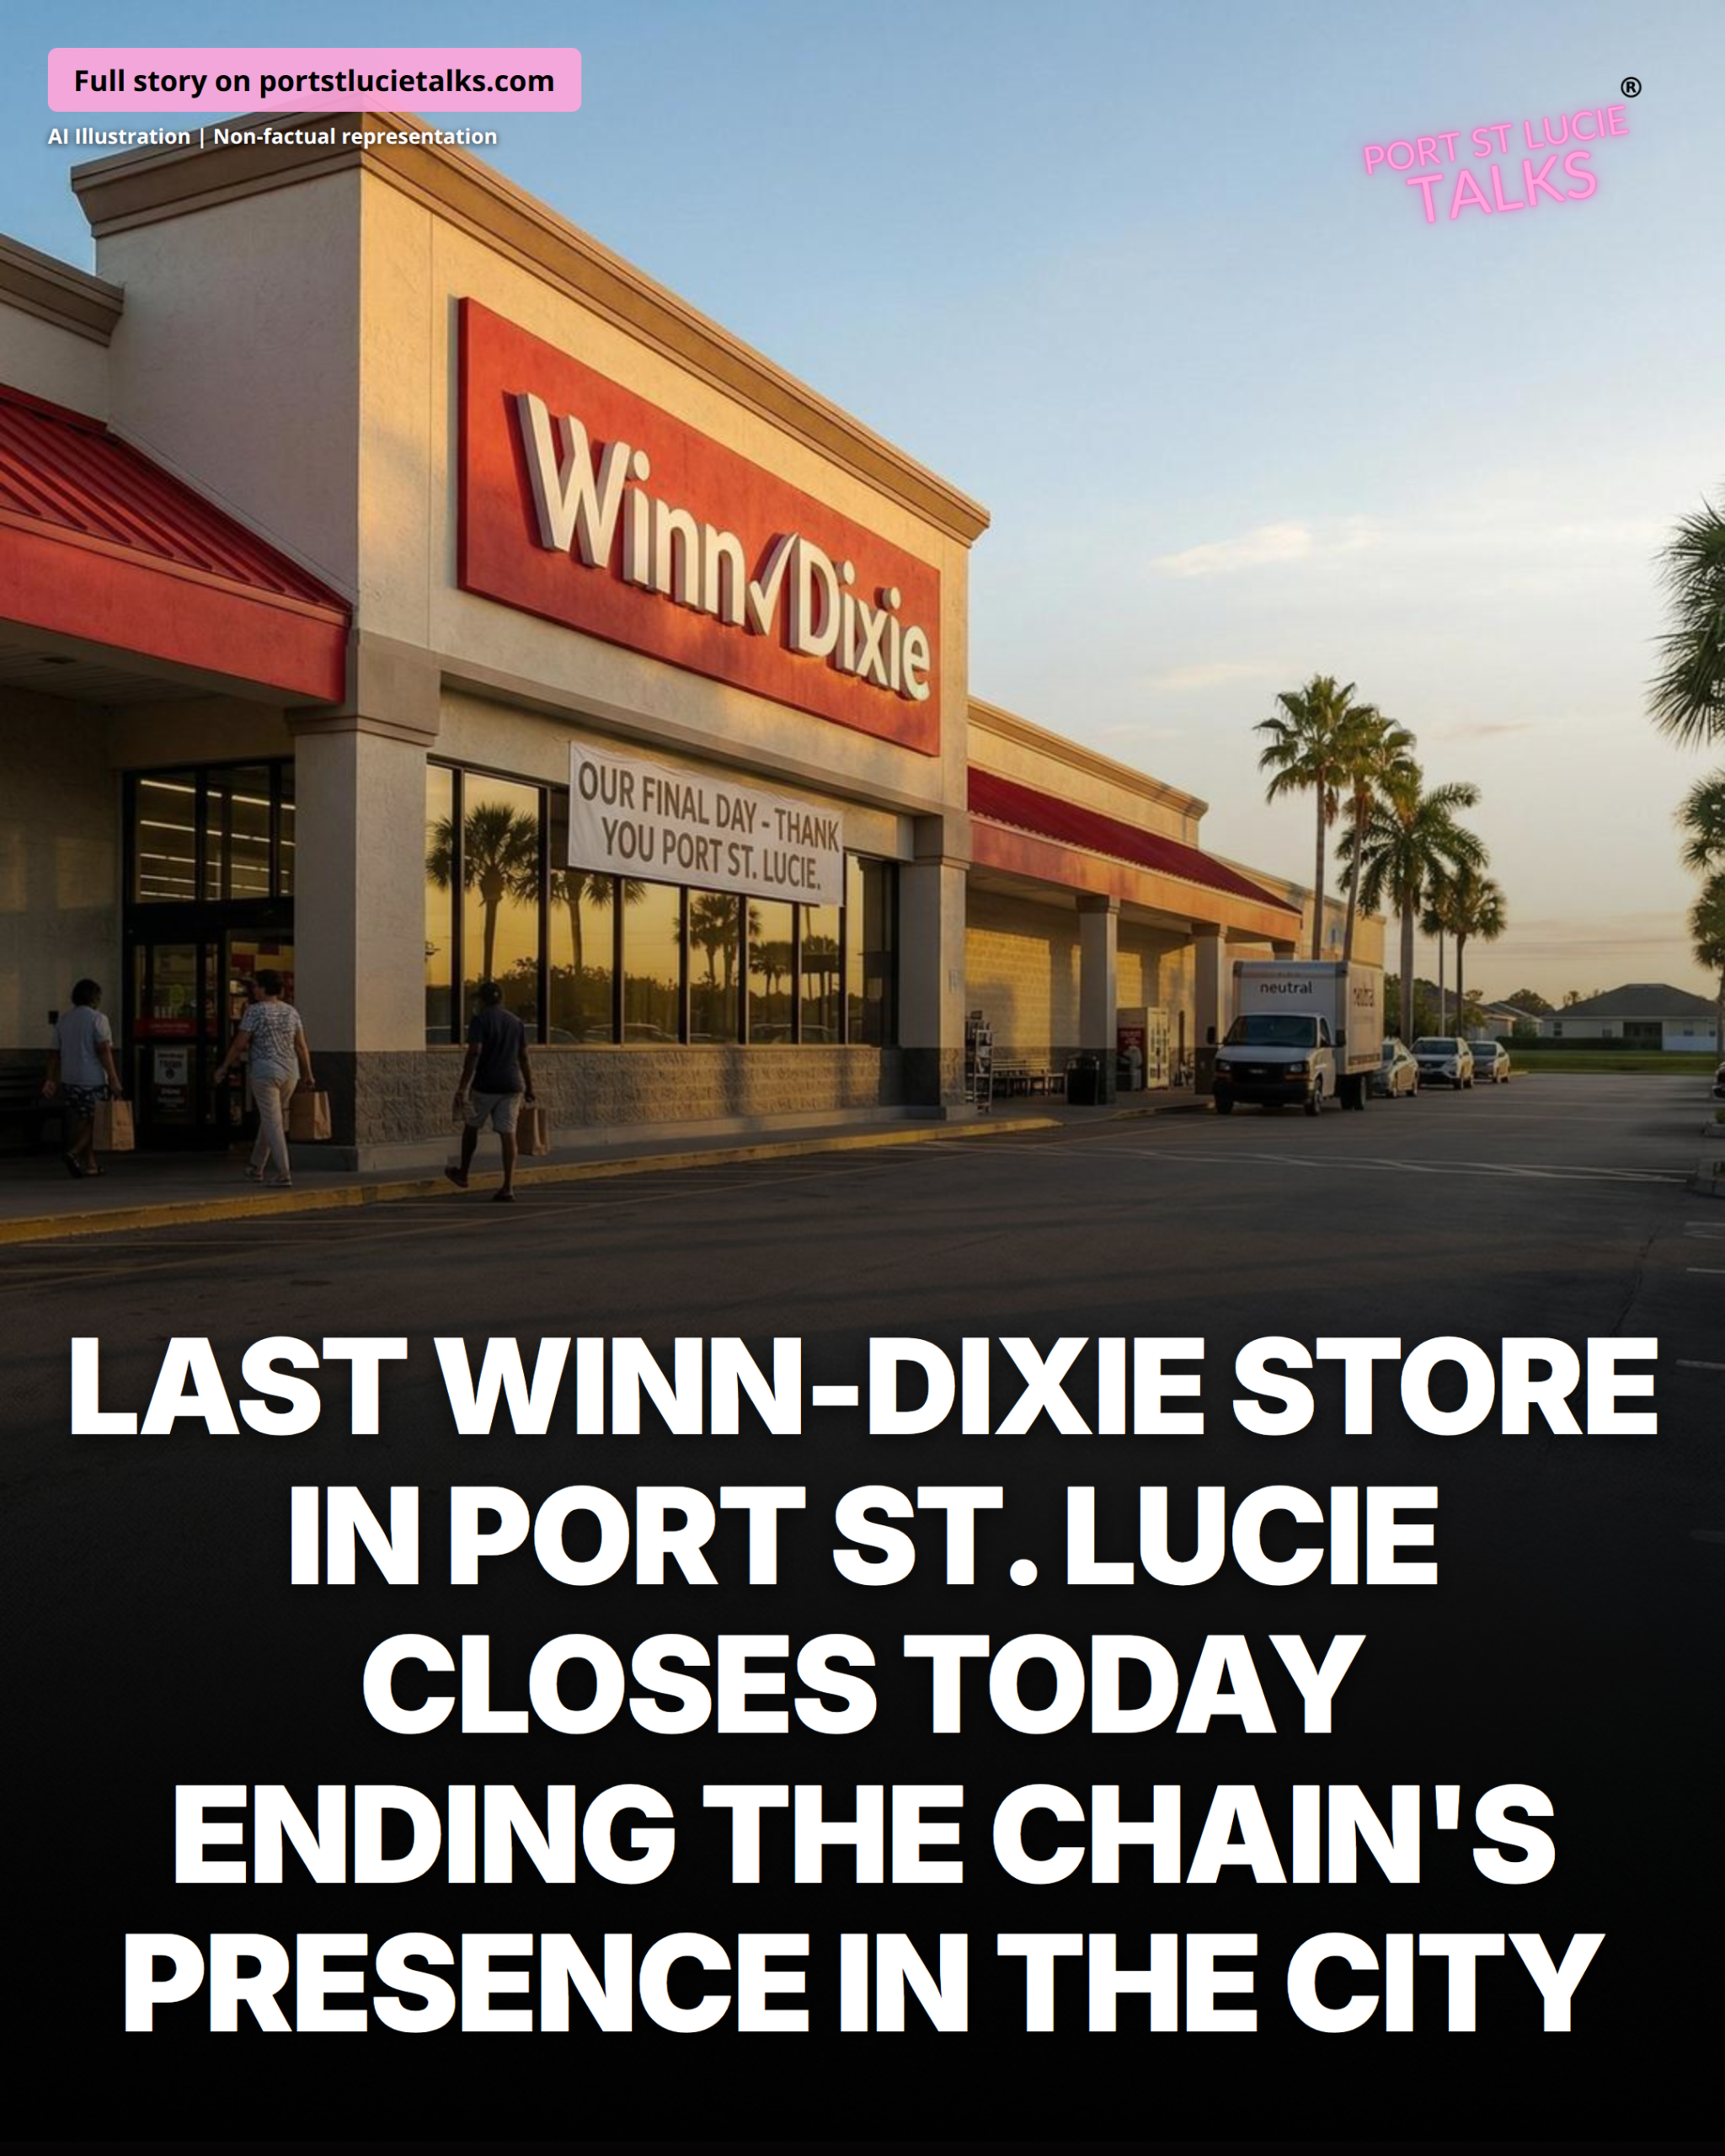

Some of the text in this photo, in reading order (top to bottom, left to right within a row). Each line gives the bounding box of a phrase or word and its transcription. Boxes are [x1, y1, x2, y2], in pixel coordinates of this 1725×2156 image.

[516, 392, 931, 702] Winn Dixie
[579, 760, 634, 809] OUR
[643, 776, 709, 825] FINAL
[717, 793, 757, 834] DAY
[774, 808, 840, 852] THANK
[601, 817, 820, 890] YOU PORT ST. LUCIE.
[1260, 981, 1312, 994] neutral
